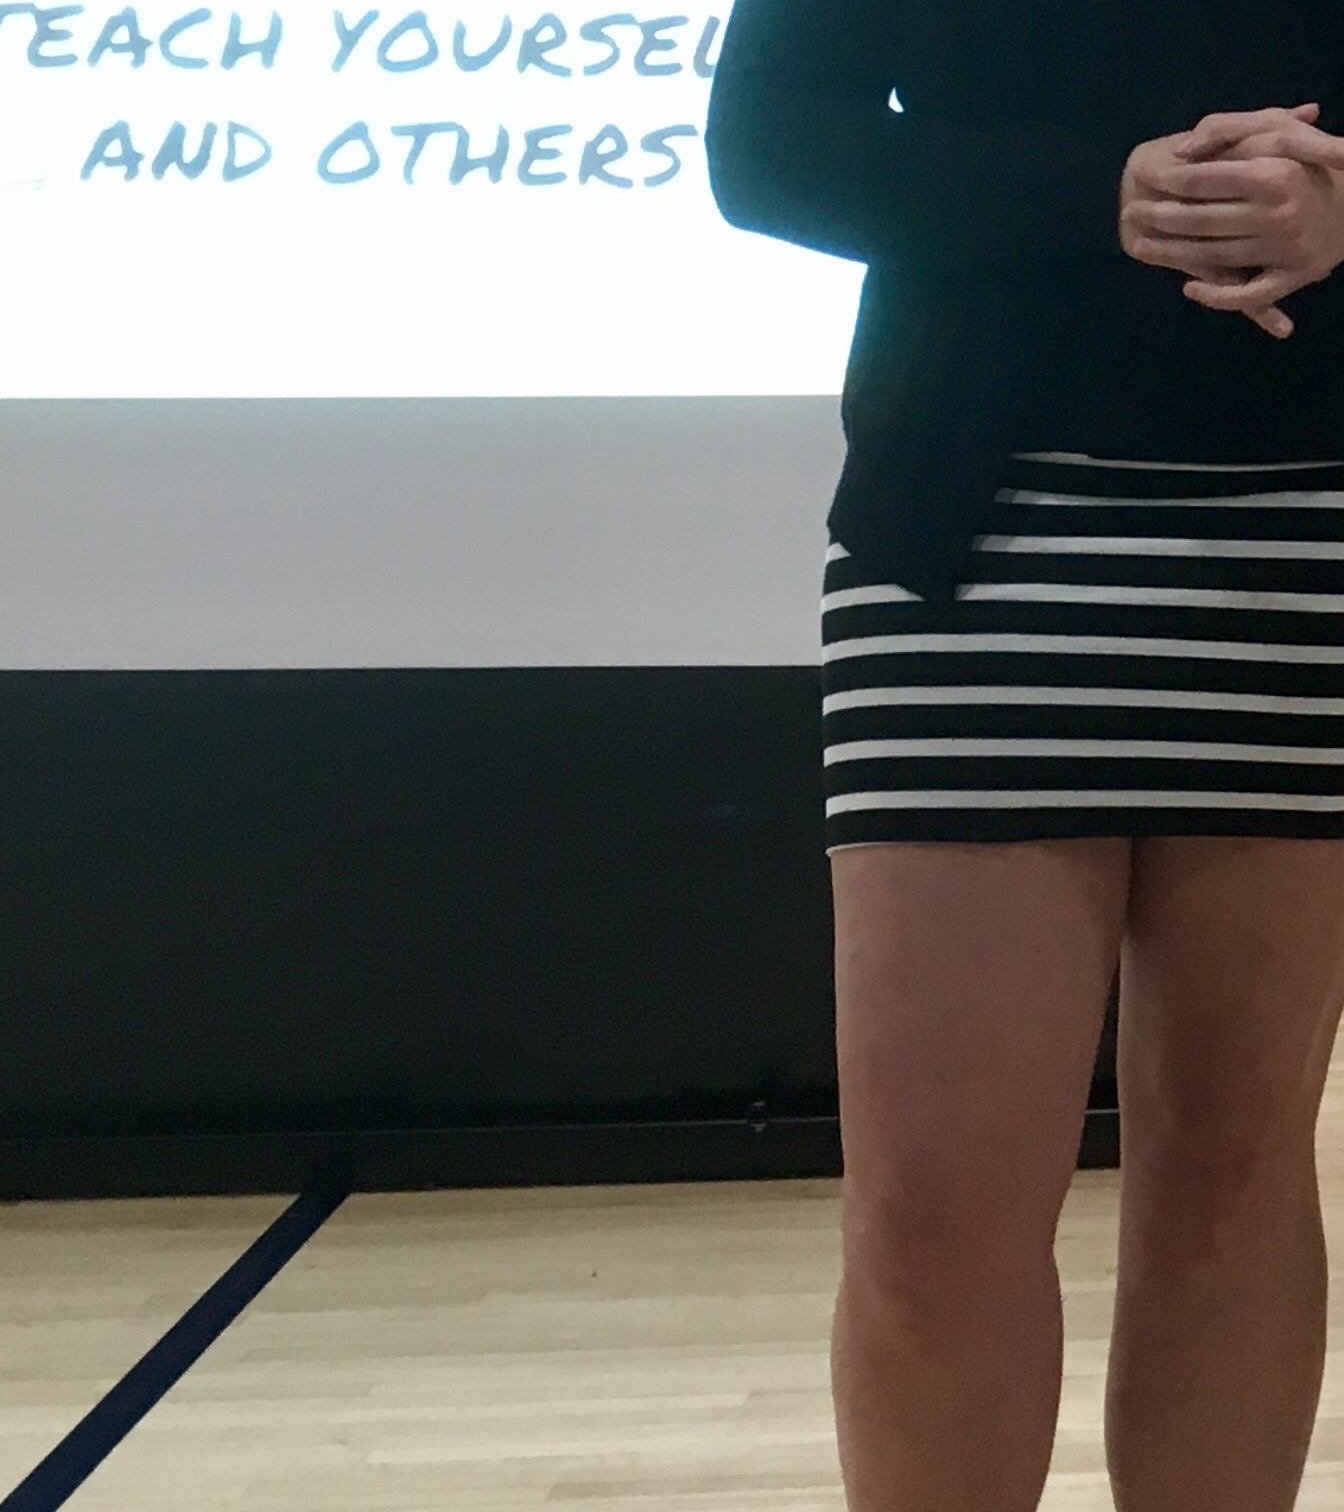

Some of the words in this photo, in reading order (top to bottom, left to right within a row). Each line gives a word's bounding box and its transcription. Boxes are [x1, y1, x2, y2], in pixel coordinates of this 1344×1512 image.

[331, 9, 721, 79] YOURSEL
[80, 120, 273, 183] AND
[316, 121, 699, 190] OTHERS
